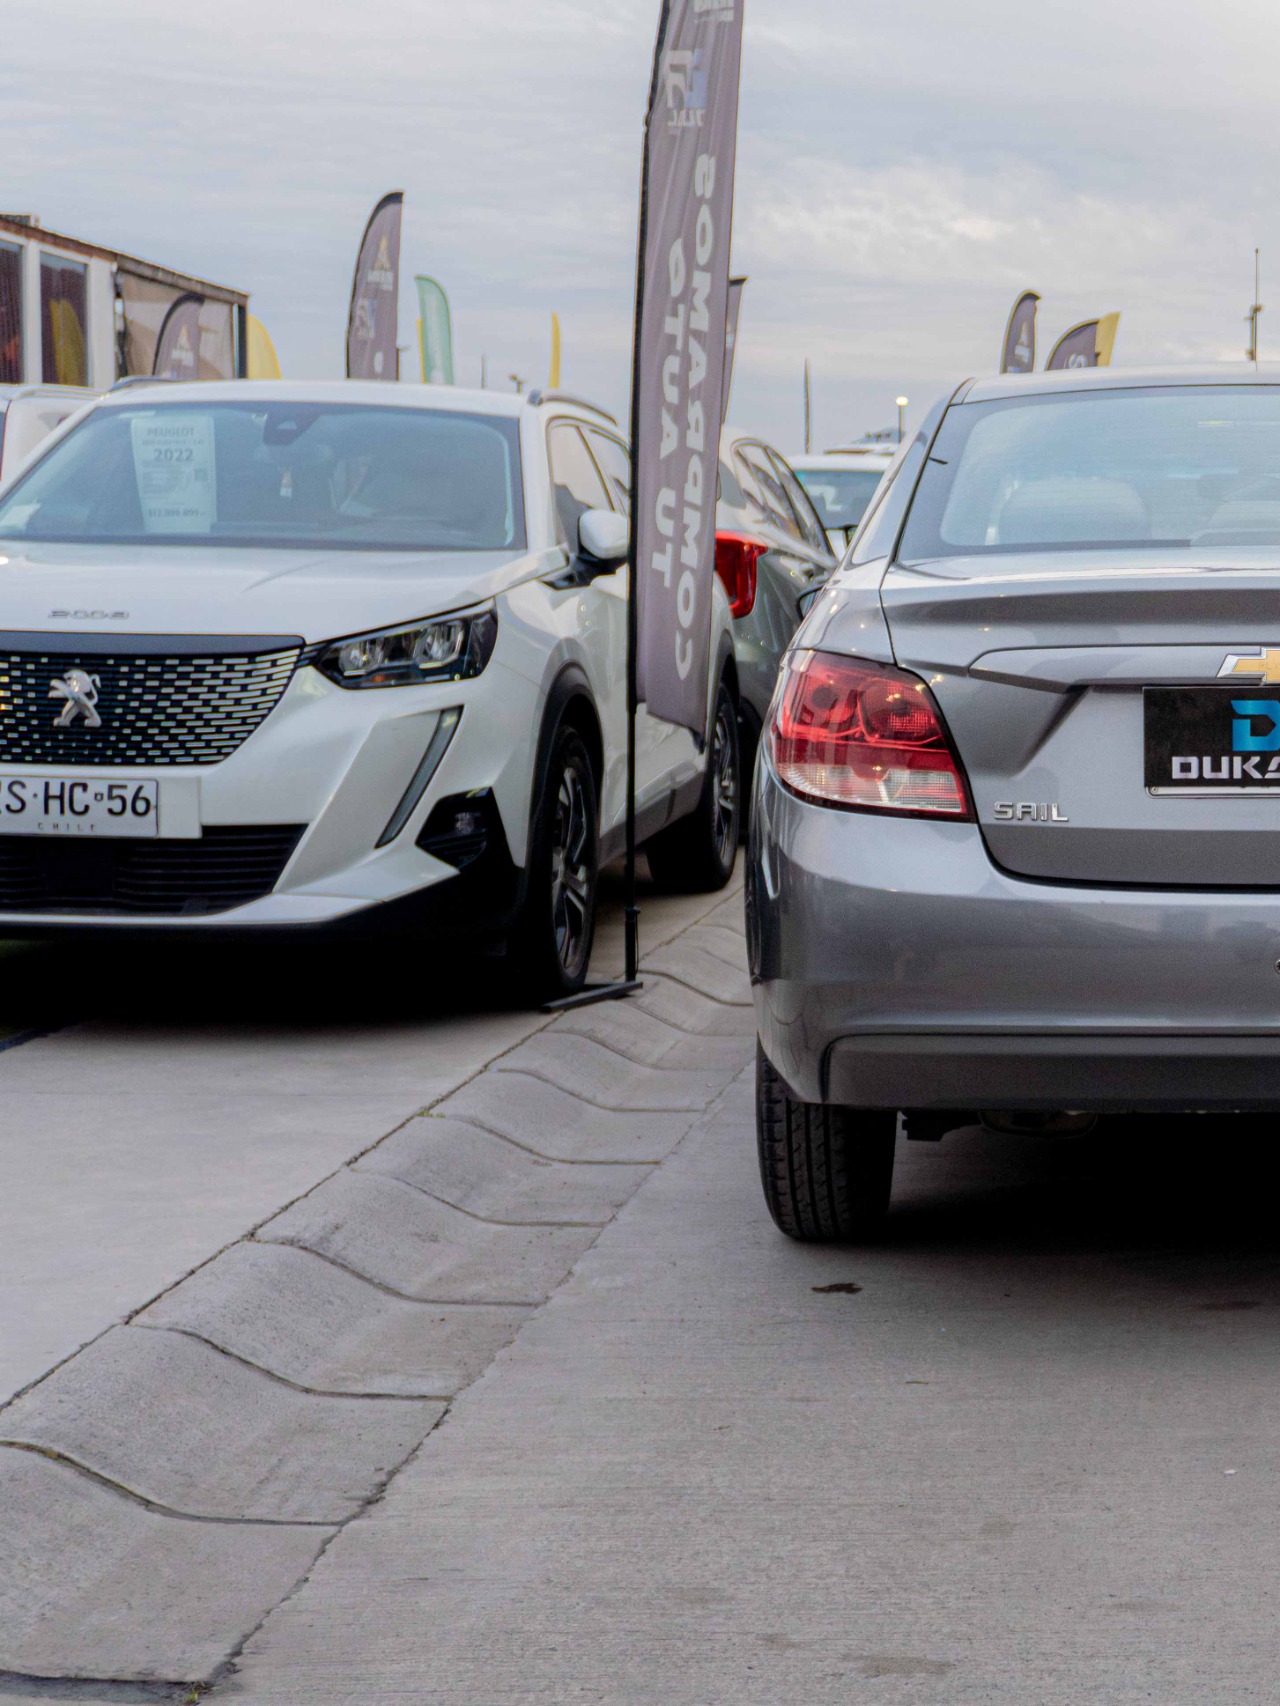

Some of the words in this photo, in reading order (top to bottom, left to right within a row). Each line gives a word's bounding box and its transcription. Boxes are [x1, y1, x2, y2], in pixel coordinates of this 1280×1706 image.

[153, 448, 194, 462] 2022
[994, 801, 1070, 823] SAIL
[37, 822, 96, 832] CHILE
